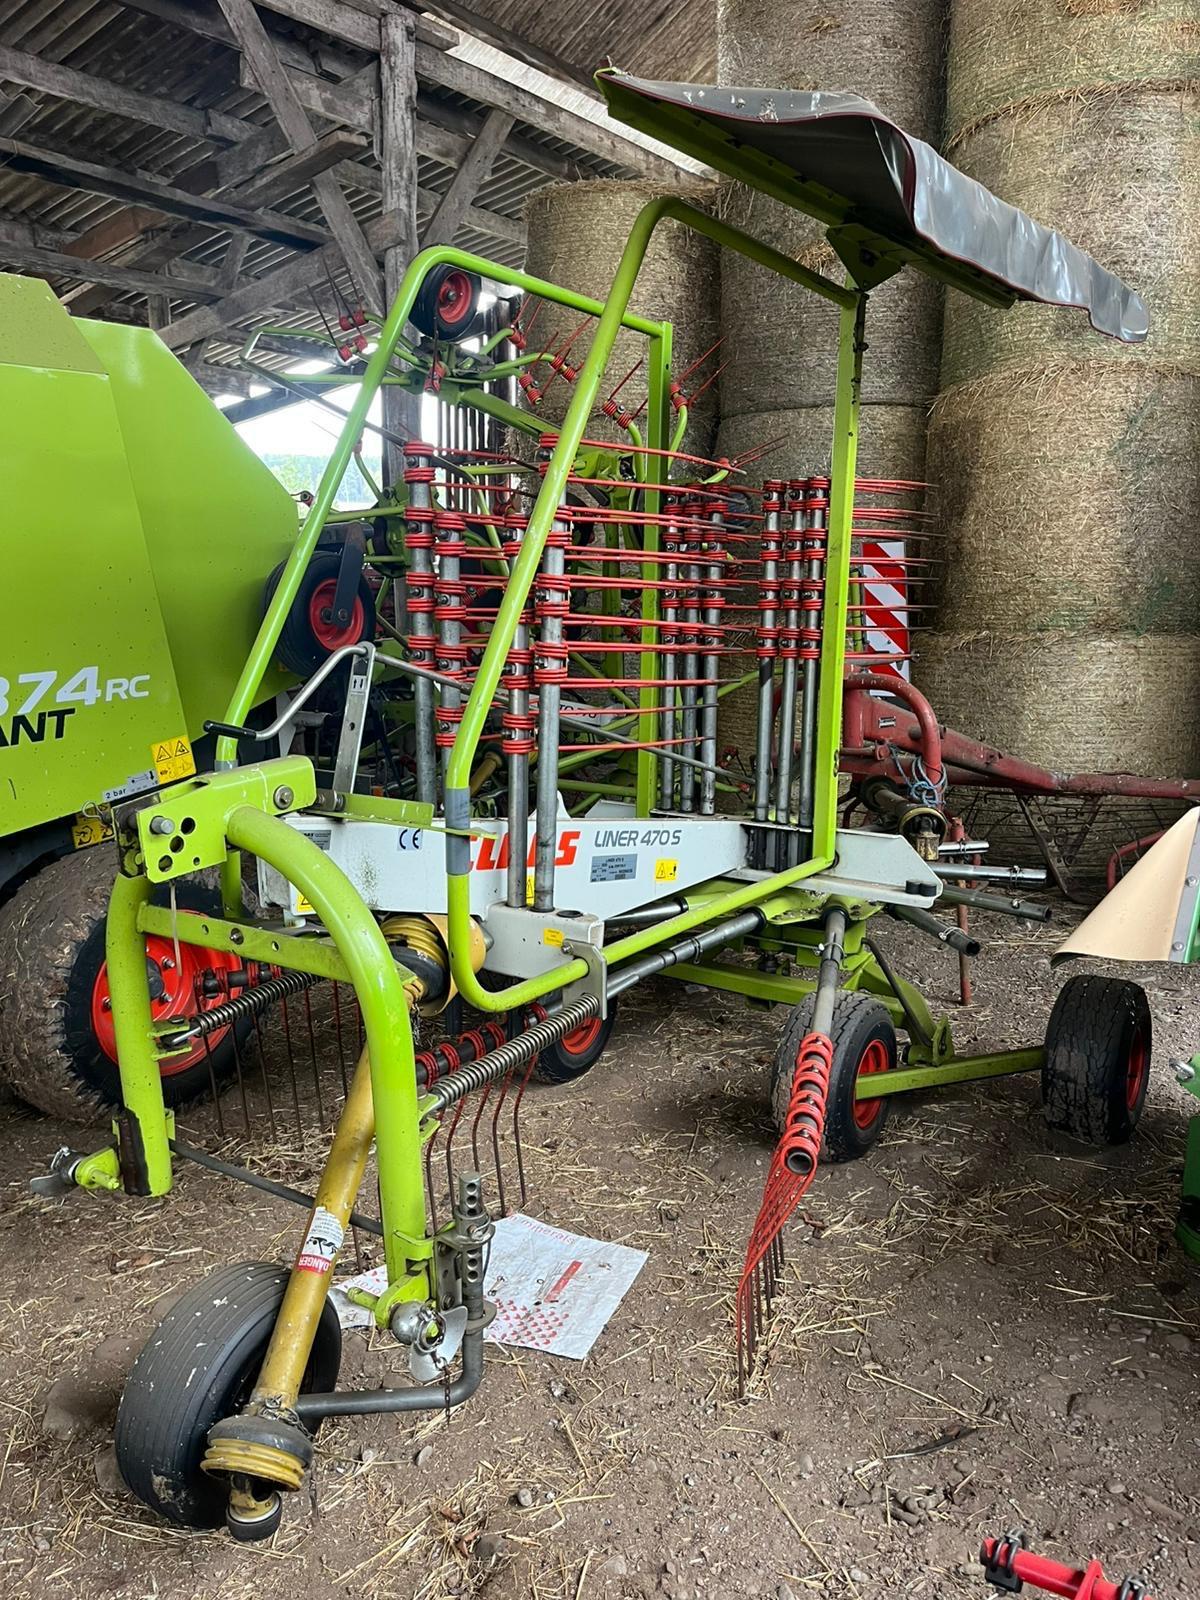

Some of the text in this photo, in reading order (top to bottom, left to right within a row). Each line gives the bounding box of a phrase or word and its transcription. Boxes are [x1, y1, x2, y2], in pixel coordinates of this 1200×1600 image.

[0, 666, 151, 717] 74 RC
[113, 788, 127, 797] bar
[399, 828, 421, 849] CE
[594, 830, 639, 848] LINER
[298, 1256, 330, 1272] DANGER
